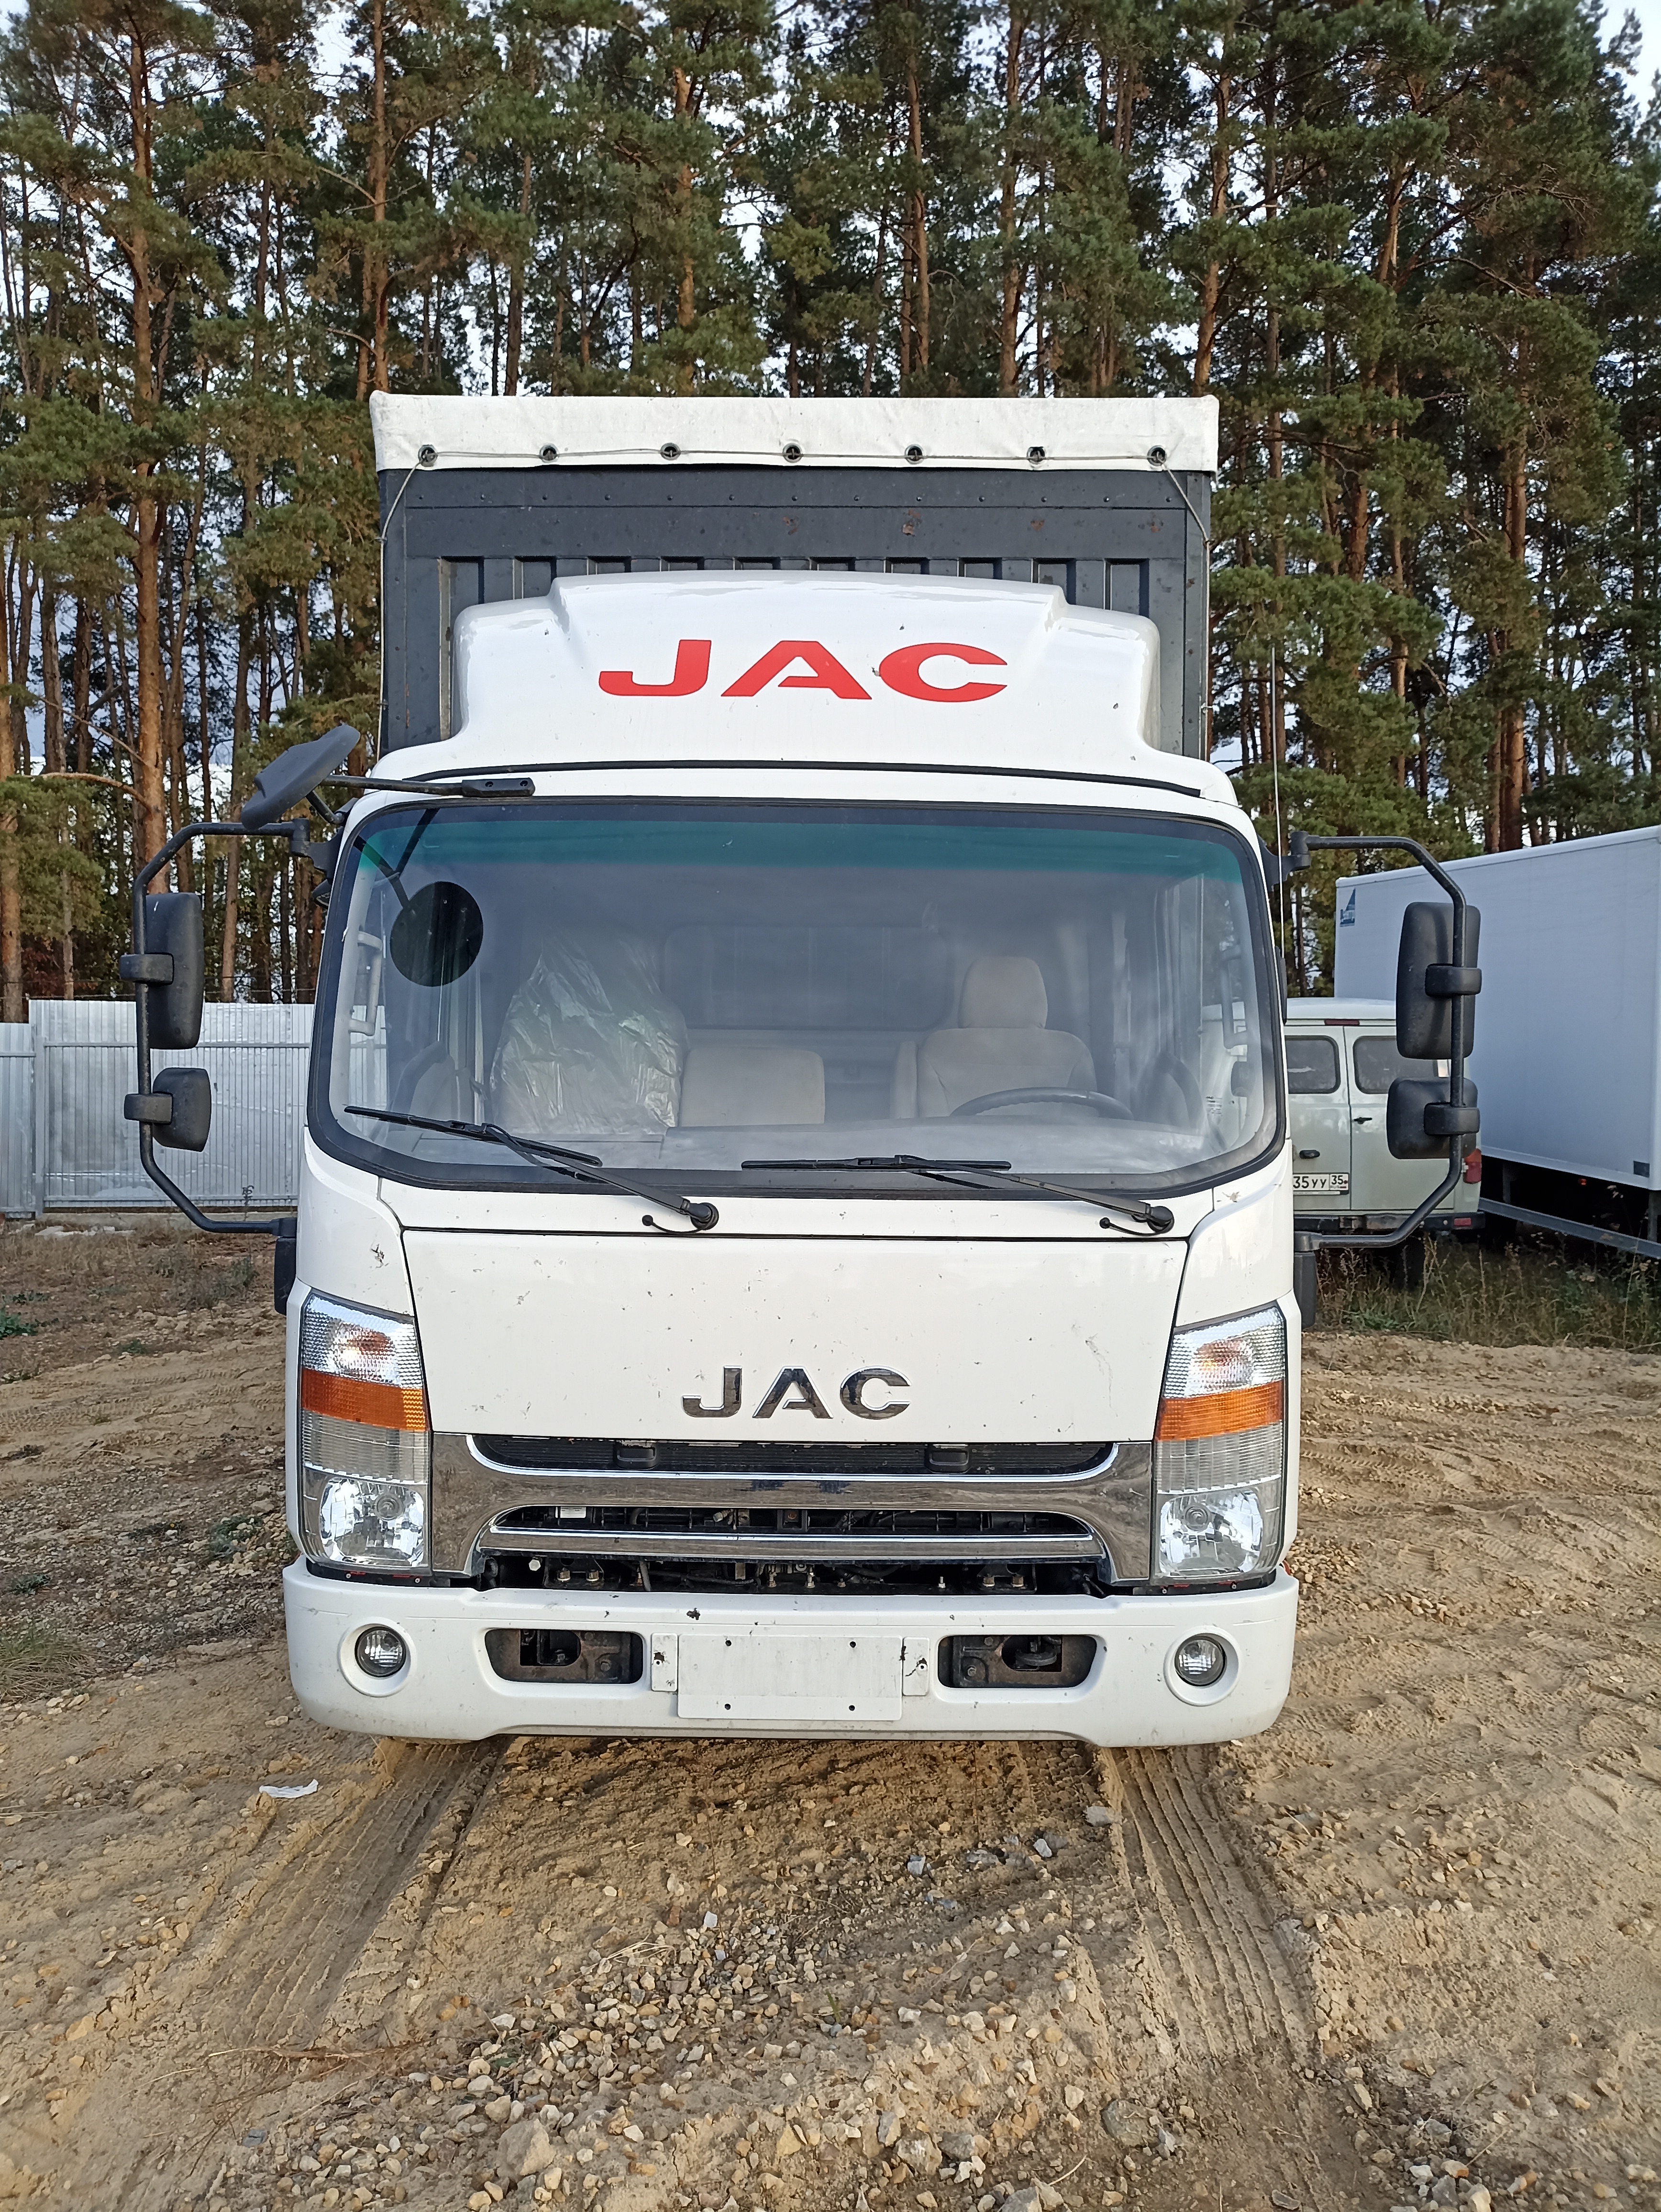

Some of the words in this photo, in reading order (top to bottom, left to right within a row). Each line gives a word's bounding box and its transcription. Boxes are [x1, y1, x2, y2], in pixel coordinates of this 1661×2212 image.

[598, 640, 1007, 702] JAC
[1331, 1175, 1343, 1185] 35
[682, 1365, 911, 1420] JAC
